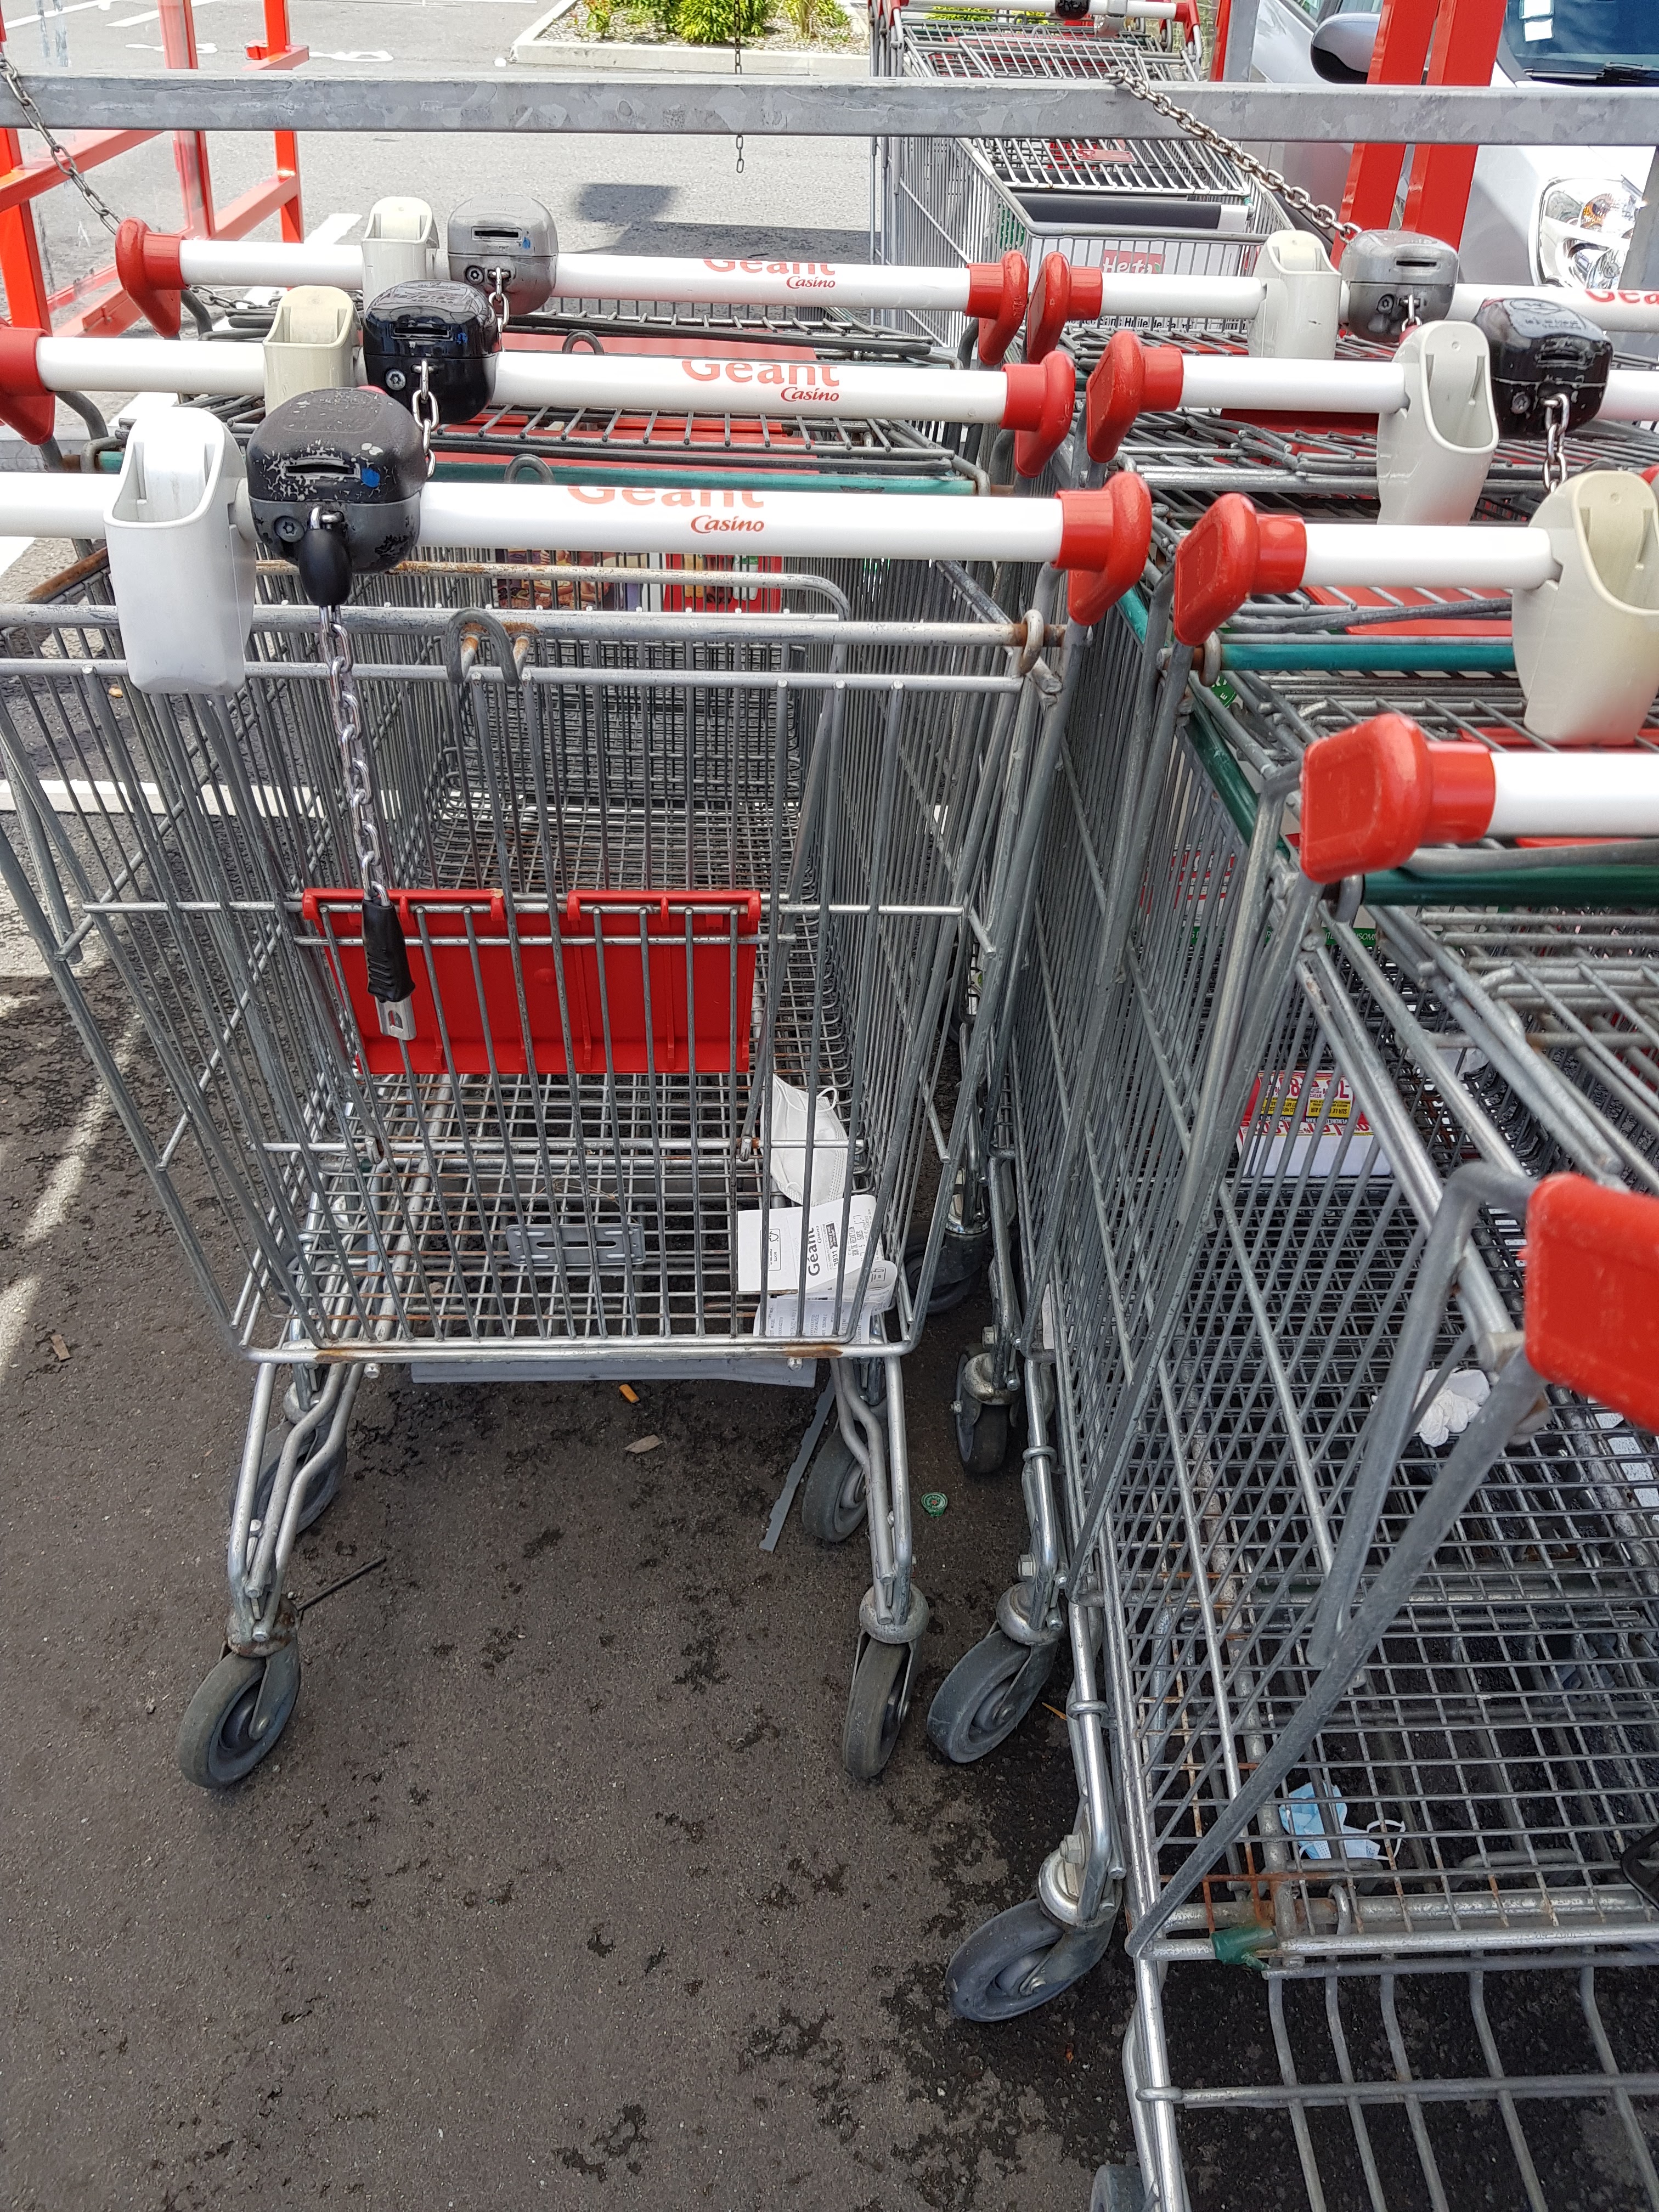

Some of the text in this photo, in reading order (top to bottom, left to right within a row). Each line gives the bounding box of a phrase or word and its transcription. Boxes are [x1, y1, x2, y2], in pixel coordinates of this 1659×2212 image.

[786, 275, 836, 289] Casino
[781, 386, 840, 402] Casino
[690, 515, 765, 534] Casino
